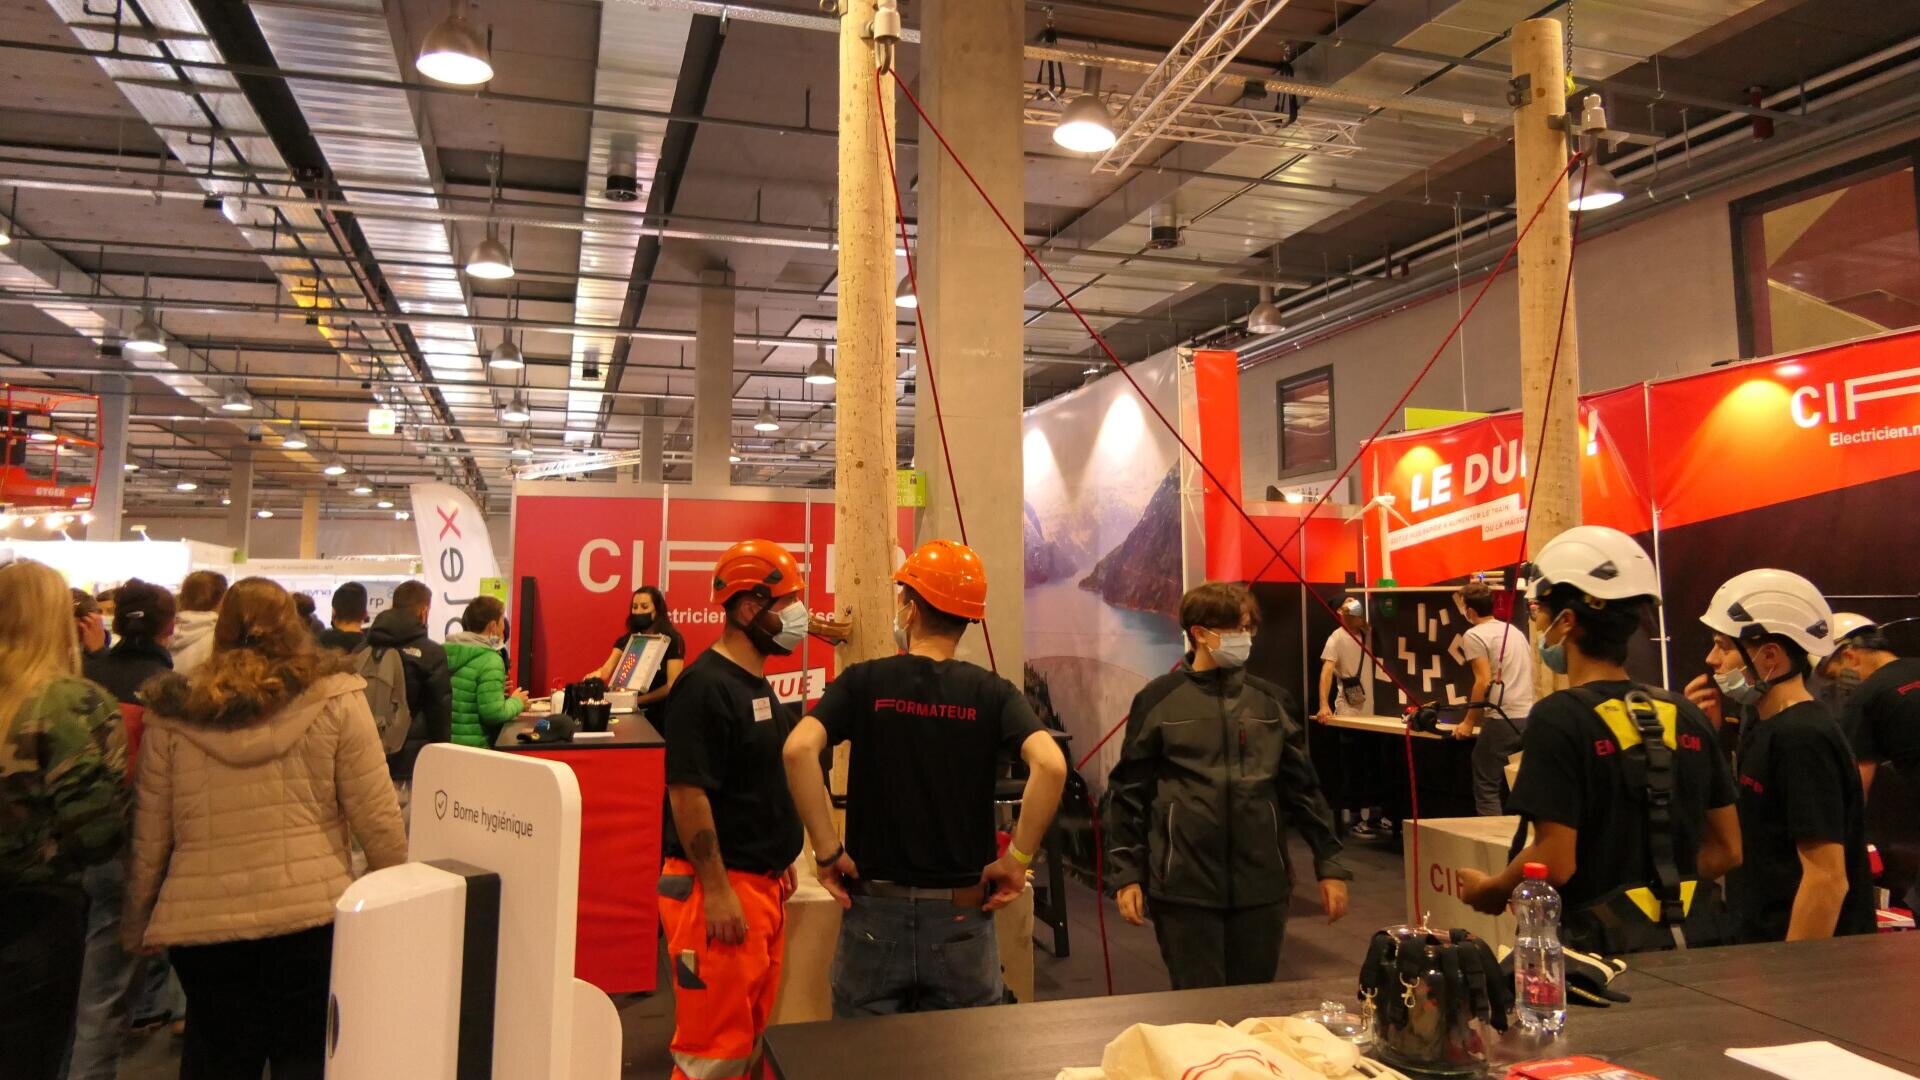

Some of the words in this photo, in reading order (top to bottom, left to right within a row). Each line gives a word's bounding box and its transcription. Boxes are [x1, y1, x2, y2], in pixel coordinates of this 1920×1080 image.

[1411, 463, 1453, 512] LE
[1463, 438, 1526, 496] DU
[771, 675, 812, 698] UE
[875, 698, 976, 721] FORMATEUR
[453, 800, 479, 823] Borne
[481, 806, 533, 839] hygiénique
